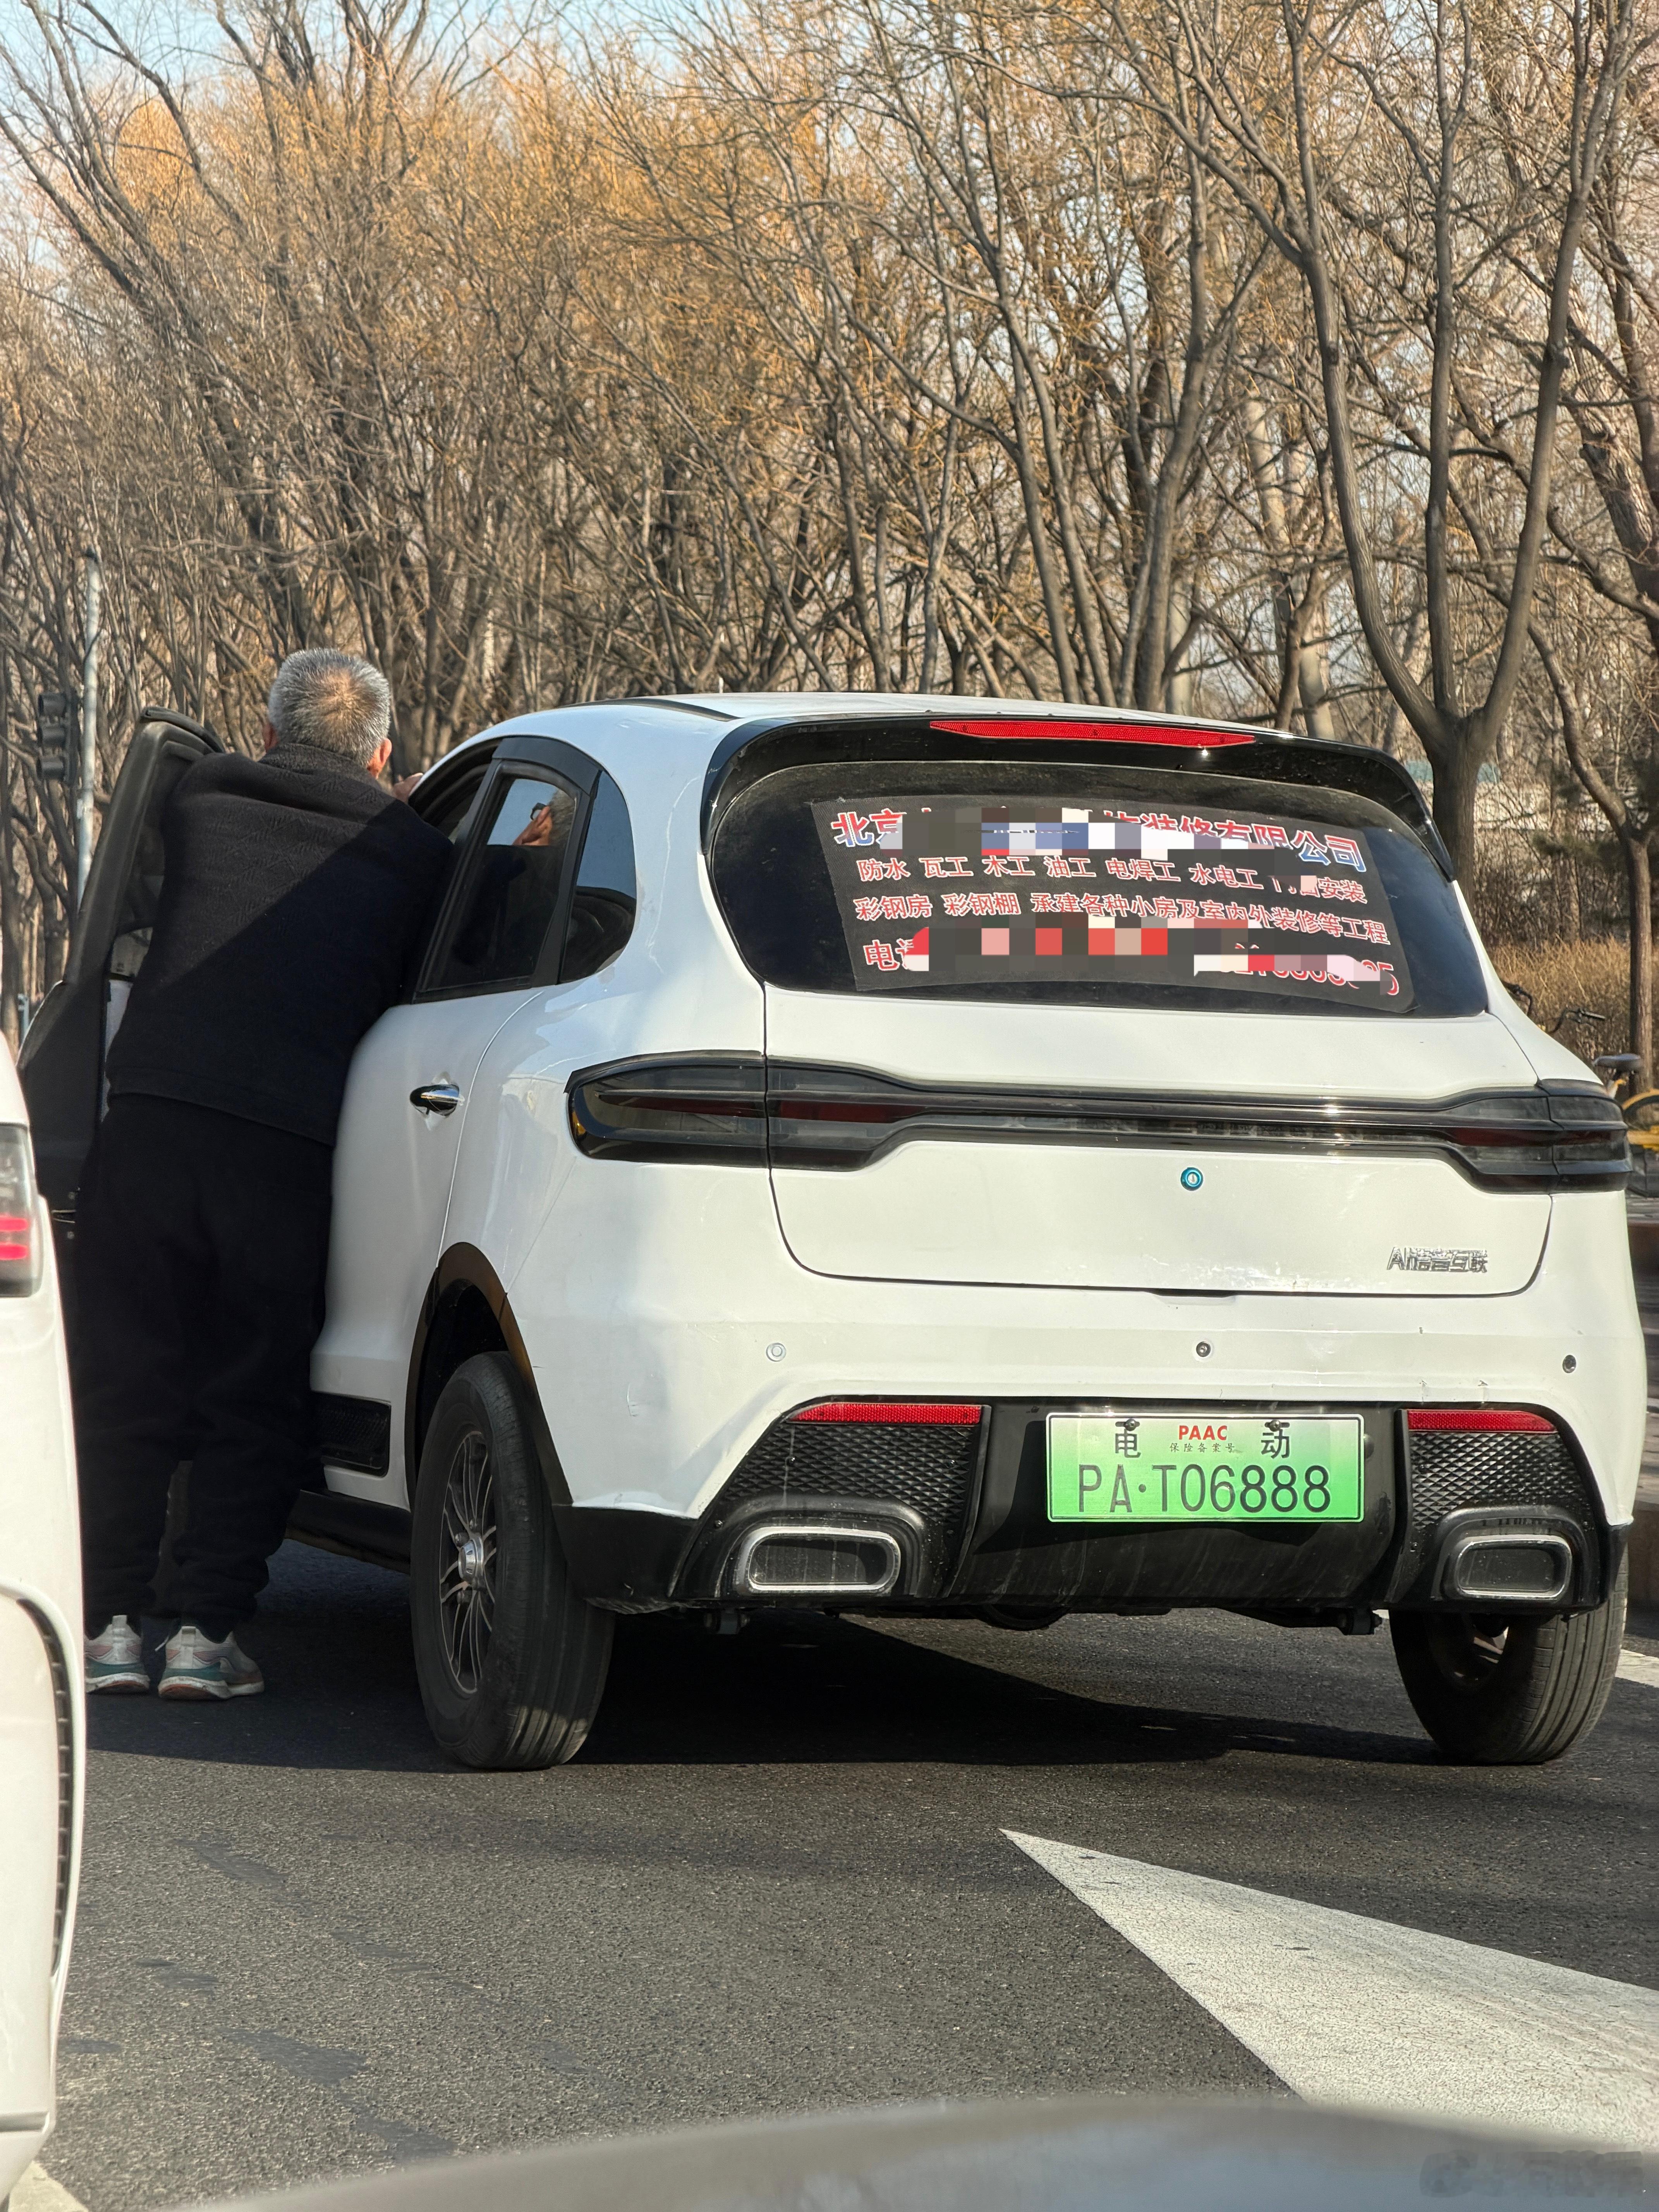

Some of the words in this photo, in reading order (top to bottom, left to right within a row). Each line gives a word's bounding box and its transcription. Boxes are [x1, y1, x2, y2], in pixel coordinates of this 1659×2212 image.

[856, 858, 910, 881] 防水
[919, 856, 974, 877] 瓦工
[982, 855, 1036, 876] 木工
[1044, 856, 1097, 878] 油工
[1105, 858, 1181, 882] 电焊工
[1188, 863, 1264, 890] 水电工
[1271, 876, 1368, 904] 安装
[854, 894, 933, 921] 彩钢房
[941, 893, 1022, 916] 彩钢棚
[1030, 892, 1391, 945] 承建各种小房及室内外装修等工程
[1115, 1428, 1142, 1458] 电
[1178, 1425, 1228, 1441] PAAC
[1261, 1427, 1291, 1459] 动
[1170, 1443, 1235, 1453] 保险备案号
